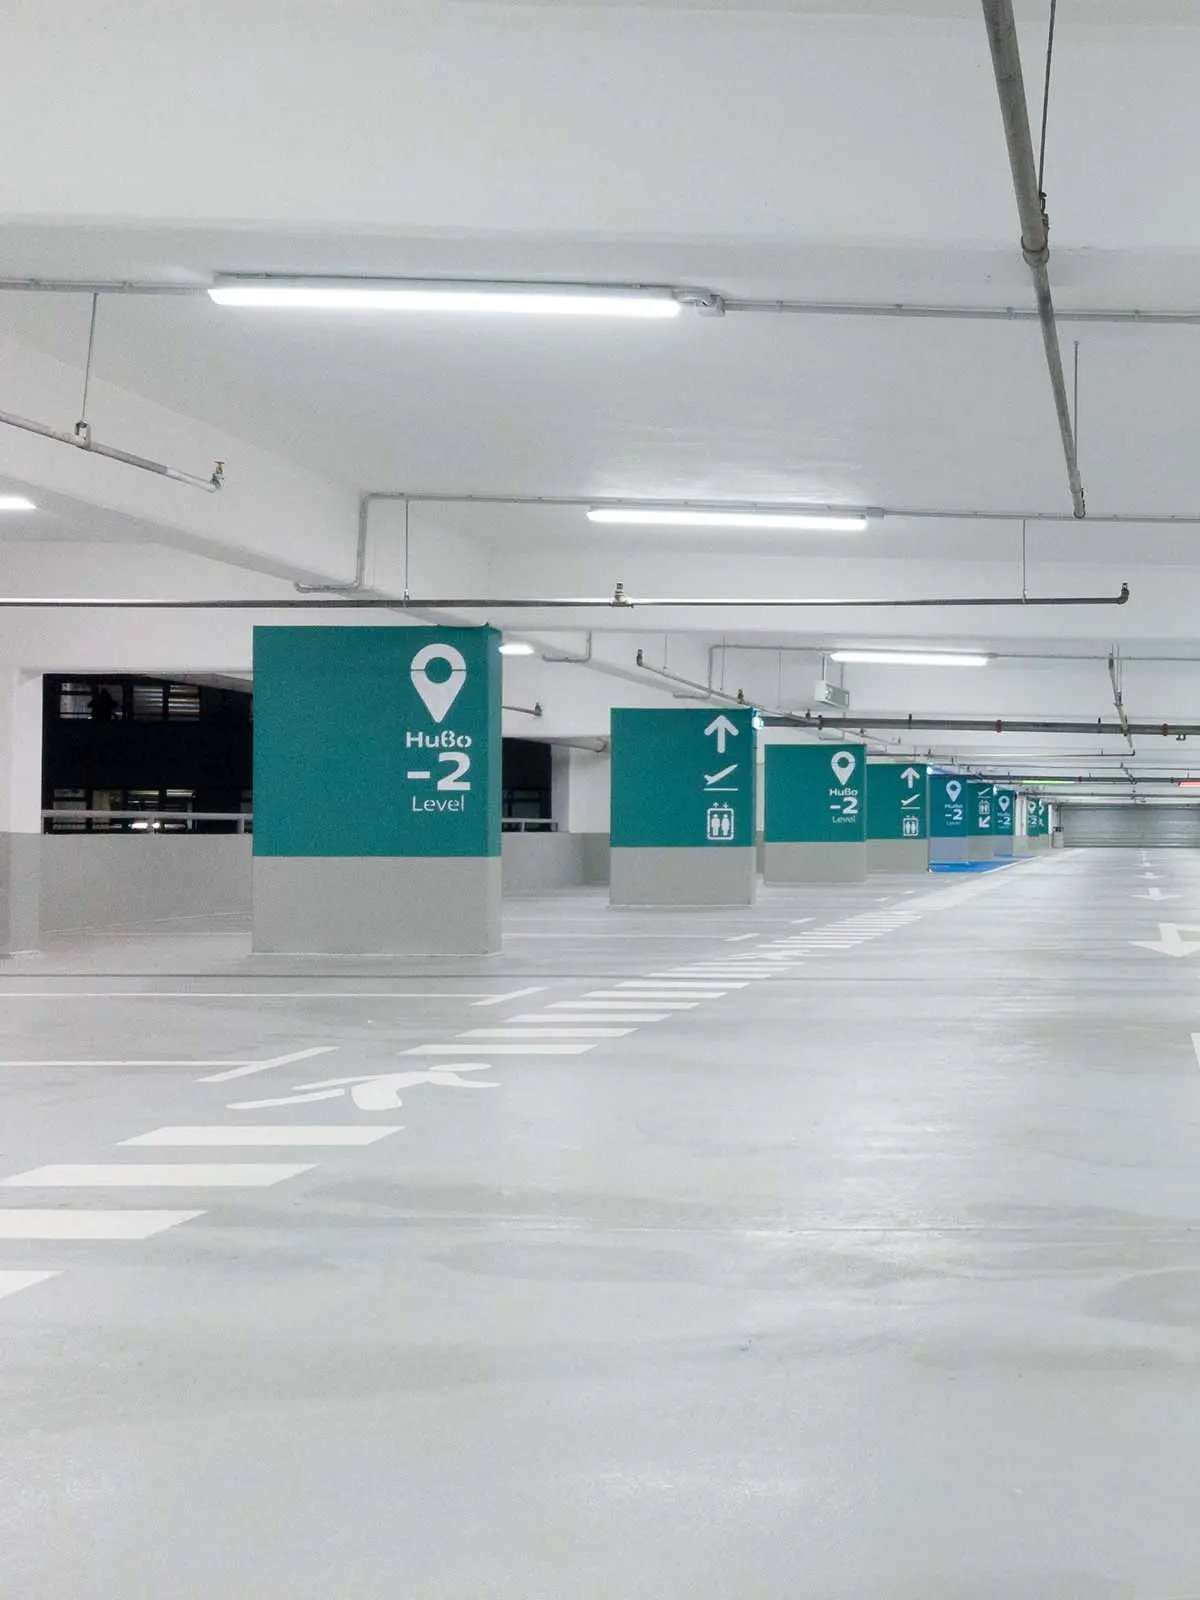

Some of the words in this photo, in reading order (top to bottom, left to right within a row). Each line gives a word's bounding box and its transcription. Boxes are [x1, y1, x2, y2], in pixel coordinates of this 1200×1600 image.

[407, 751, 471, 791] -2
[412, 795, 464, 812] Level
[830, 796, 858, 814] -2
[832, 815, 856, 823] Level
[945, 808, 963, 820] -2
